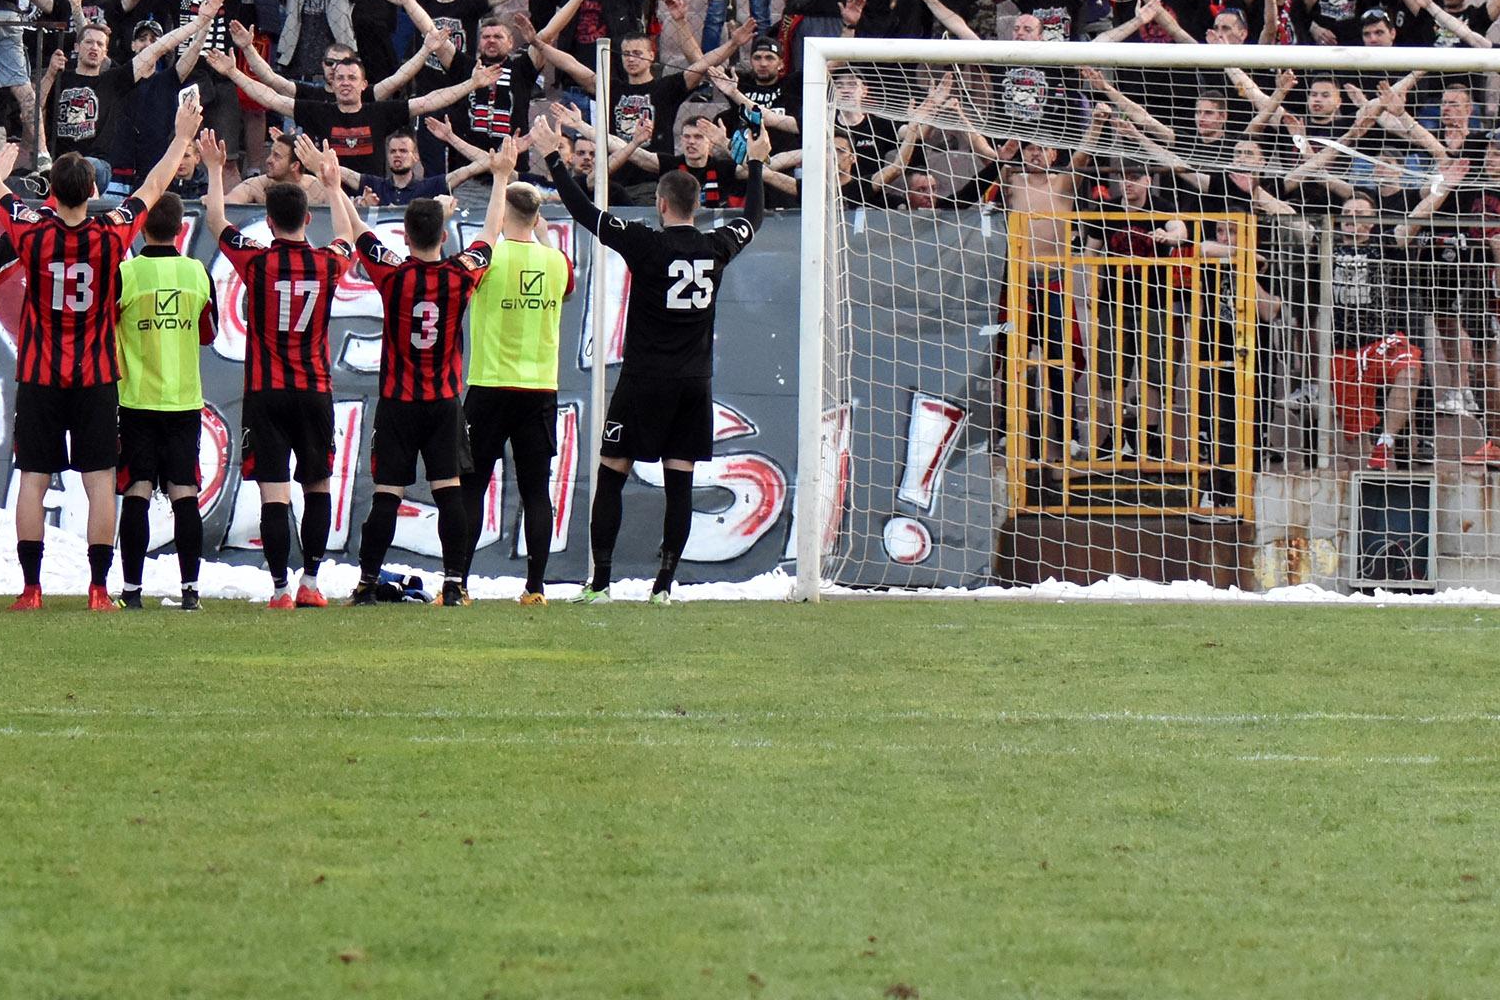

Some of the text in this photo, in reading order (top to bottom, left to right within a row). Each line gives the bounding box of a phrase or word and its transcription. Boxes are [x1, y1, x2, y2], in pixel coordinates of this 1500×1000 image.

[47, 261, 94, 312] 13
[274, 280, 320, 333] 17
[500, 298, 556, 311] GIVOVA
[665, 259, 714, 310] 25
[410, 301, 439, 350] 3
